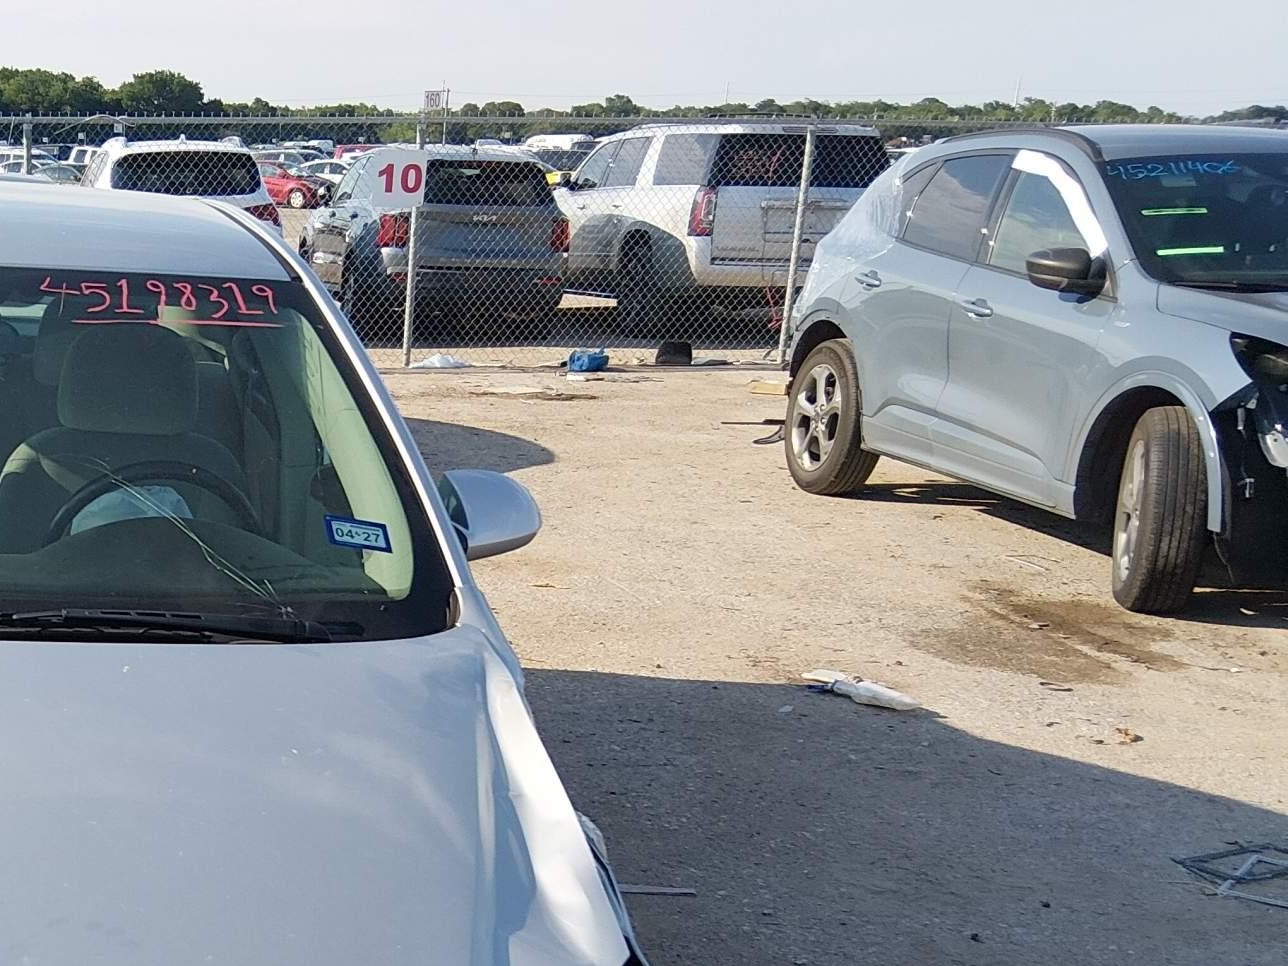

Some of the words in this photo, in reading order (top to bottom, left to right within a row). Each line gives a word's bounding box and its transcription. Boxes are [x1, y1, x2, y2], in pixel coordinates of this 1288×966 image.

[425, 93, 441, 108] 160
[377, 163, 423, 194] 10
[40, 276, 278, 319] 45198319
